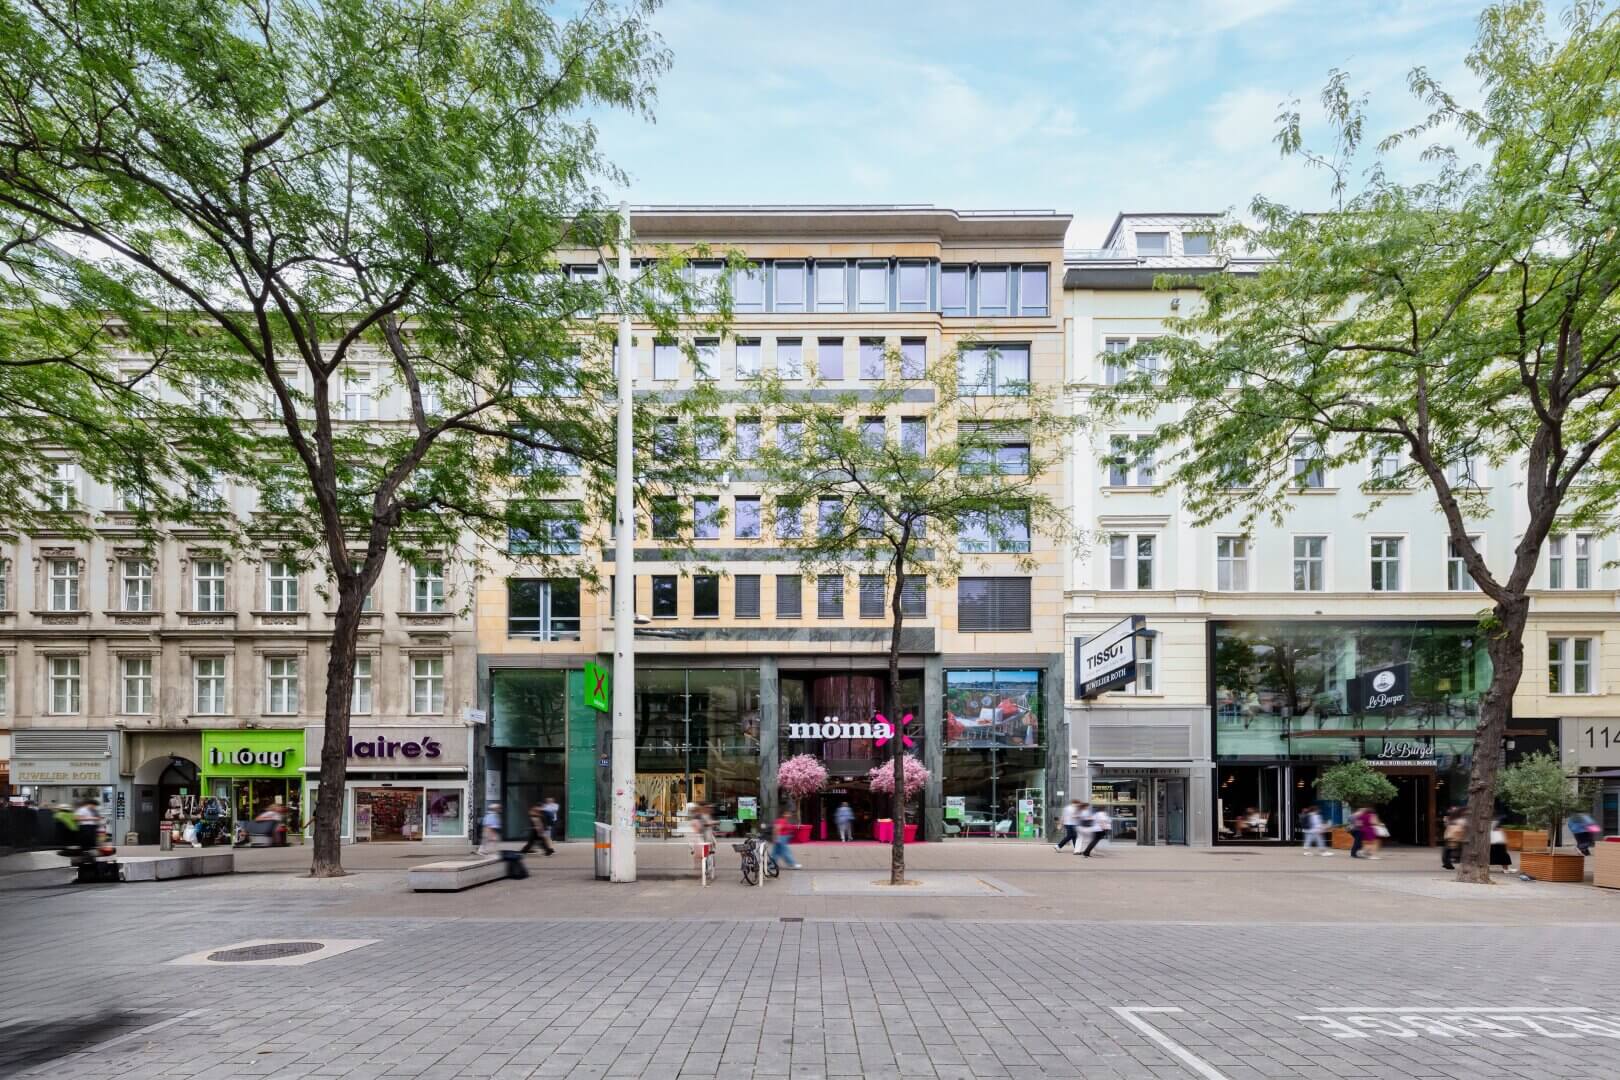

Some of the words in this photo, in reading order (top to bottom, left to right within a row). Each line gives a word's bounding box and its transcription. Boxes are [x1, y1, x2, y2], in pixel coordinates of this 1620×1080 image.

[1111, 667, 1127, 682] ROTH
[1365, 695, 1378, 710] Le
[1377, 693, 1405, 707] Burger
[1378, 741, 1396, 758] Le
[1397, 742, 1433, 759] Burger
[72, 771, 101, 780] ROTH
